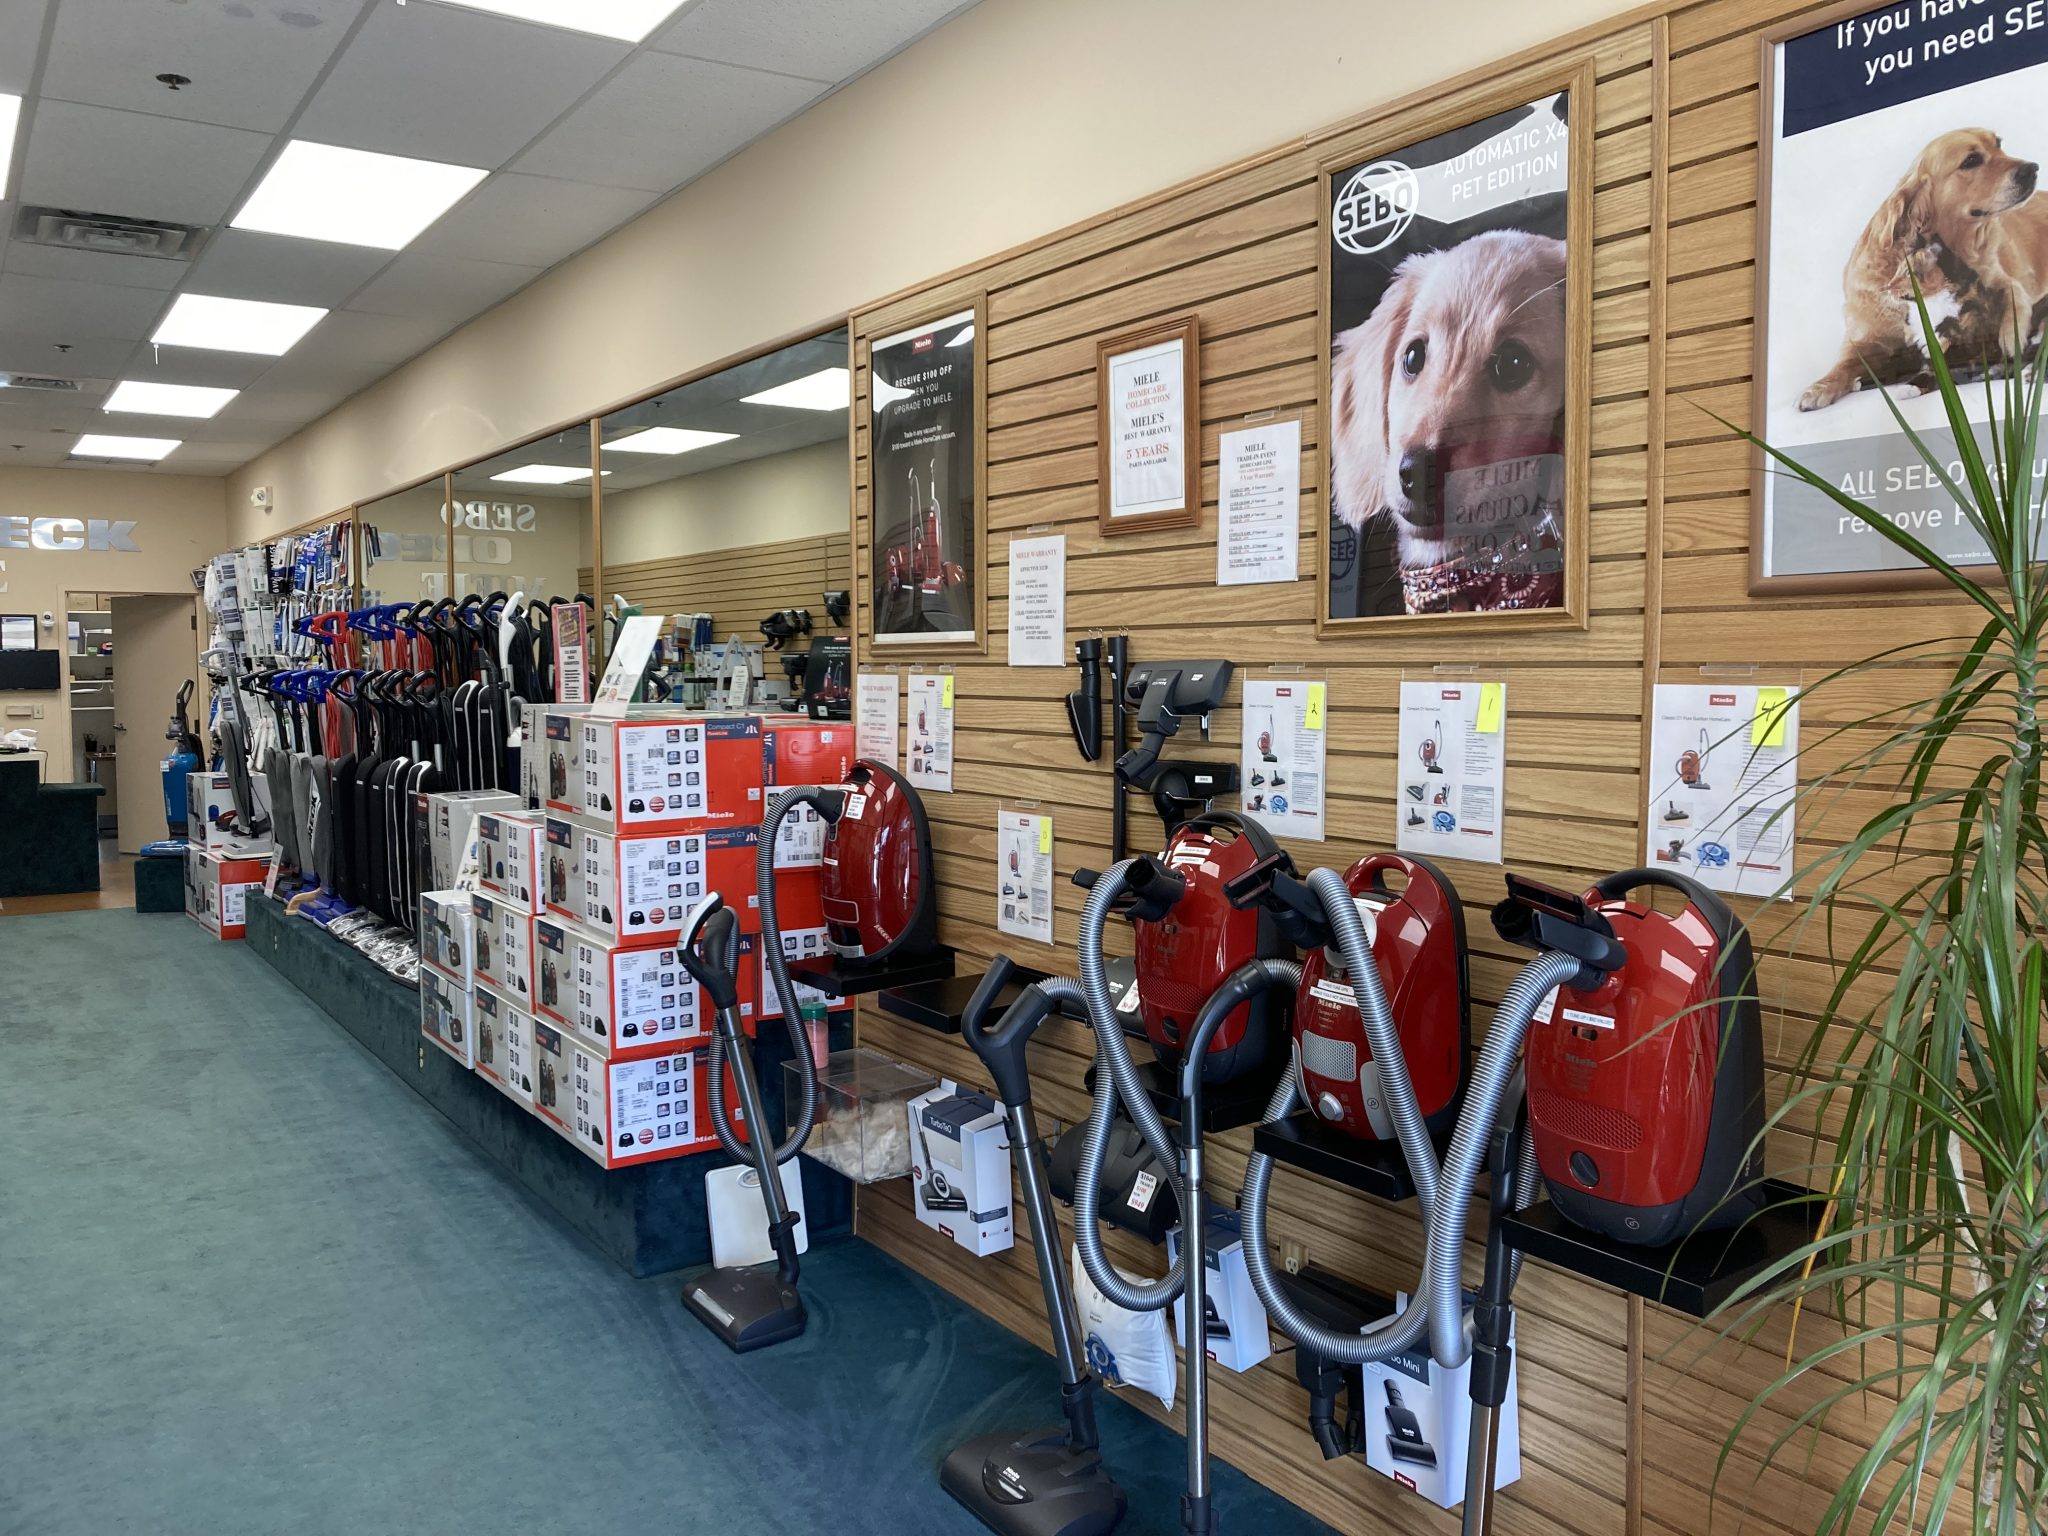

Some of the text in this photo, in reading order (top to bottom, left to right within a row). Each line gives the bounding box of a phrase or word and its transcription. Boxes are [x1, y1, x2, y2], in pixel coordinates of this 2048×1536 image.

[1837, 20, 1855, 49] If
[1862, 8, 1910, 47] you
[1864, 46, 1912, 85] you
[1923, 14, 1994, 61] need
[1443, 118, 1568, 178] AUTOMATIC X4
[1452, 151, 1558, 202] PET EDITION
[1338, 177, 1413, 235] SEBO
[914, 338, 932, 349] Miele
[895, 364, 953, 388] RECEIVE $100 OFF
[1134, 371, 1160, 387] MIELE
[925, 382, 939, 393] YOU
[1127, 384, 1167, 400] HOMECARE
[893, 400, 921, 415] UPGRADE
[922, 397, 932, 407] TO
[1125, 393, 1170, 410] COLLECTION
[1130, 412, 1165, 429] MIELE'S
[1124, 424, 1172, 441] BEST WARRANTY
[1126, 442, 1169, 460] 5 YEARS
[1244, 442, 1265, 453] MIELE
[1260, 451, 1276, 459] EVENT
[1840, 468, 1876, 496] All
[1762, 701, 1776, 722] 4
[706, 722, 745, 731] Compact C1
[1317, 998, 1342, 1010] Miele
[1565, 1052, 1599, 1068] Miele
[940, 1227, 953, 1238] Miele
[1402, 1357, 1420, 1374] Mini
[1396, 1474, 1414, 1489] Miele
